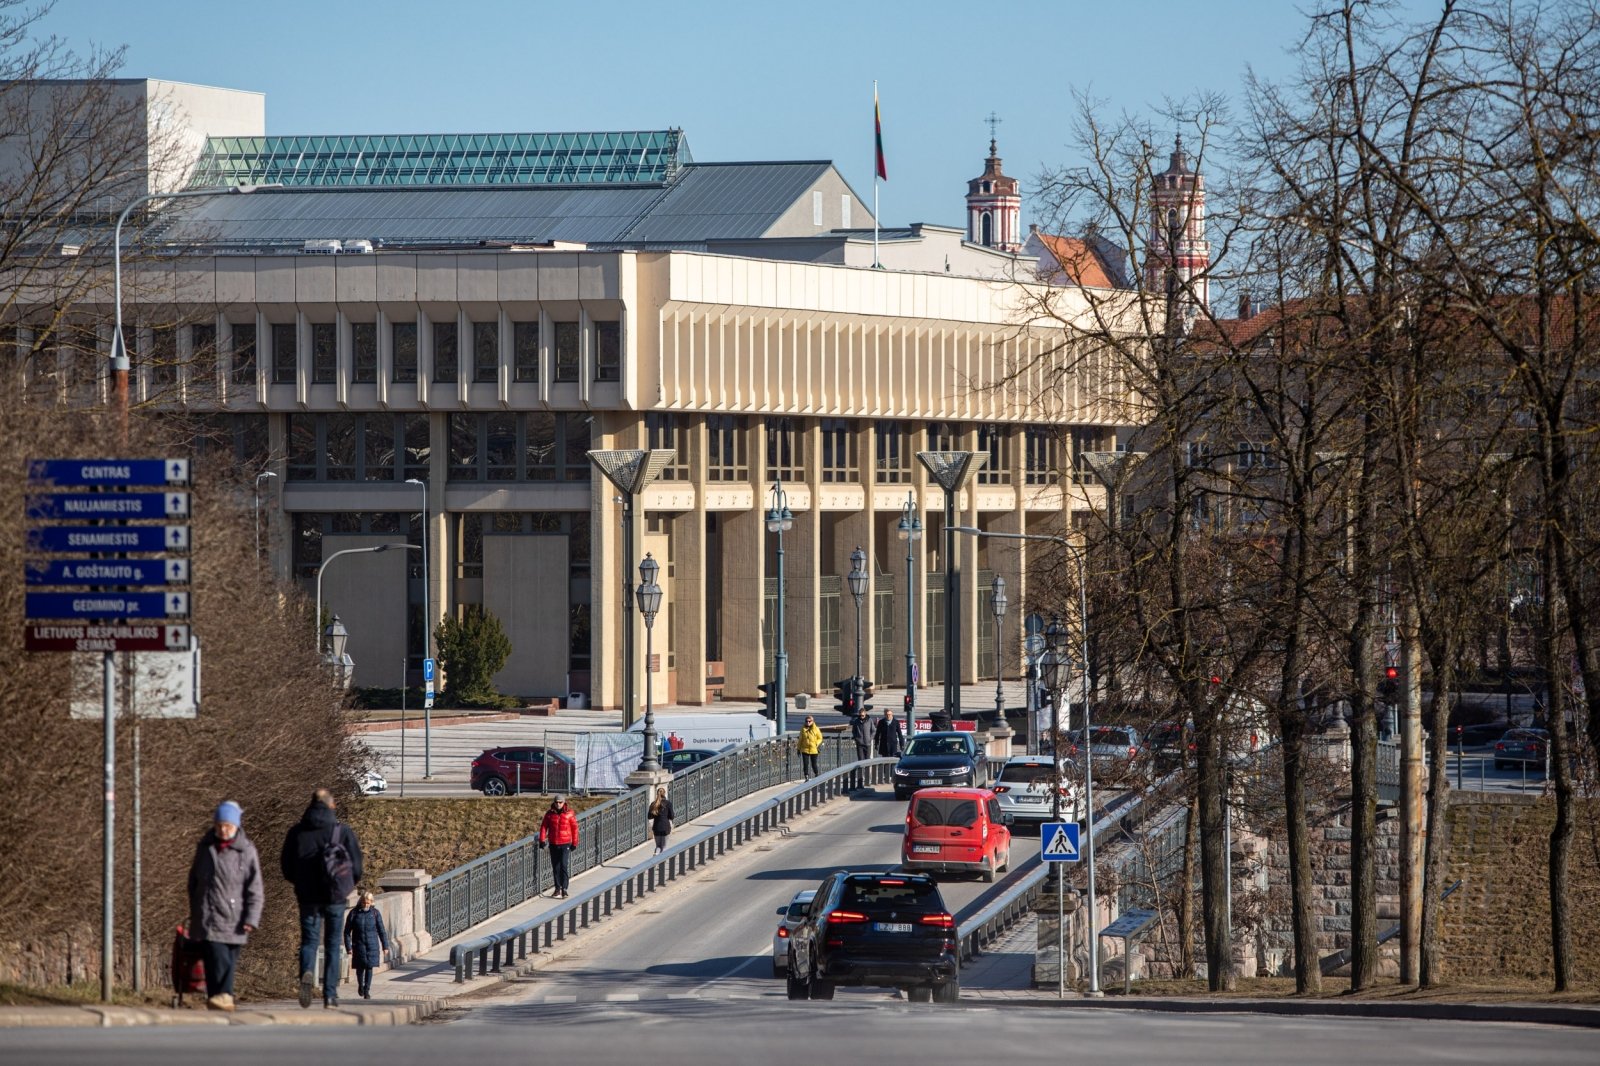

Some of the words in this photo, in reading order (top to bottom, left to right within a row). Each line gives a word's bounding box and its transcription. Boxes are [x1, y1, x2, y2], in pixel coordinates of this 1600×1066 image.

[81, 466, 131, 479] CENTRAS
[64, 500, 142, 512] NAUJAMIESTIS
[68, 533, 139, 546] SENAMIESTIS
[62, 566, 74, 578] A.
[76, 563, 132, 578] GOŠTAUTO
[133, 568, 144, 580] g.
[72, 599, 125, 612] GEDIMINO
[126, 602, 140, 613] pr.
[34, 627, 85, 639] LIETUVOS
[86, 627, 159, 639] RESPUBLIKOS
[76, 639, 117, 651] SEIMAS
[426, 661, 433, 678] P
